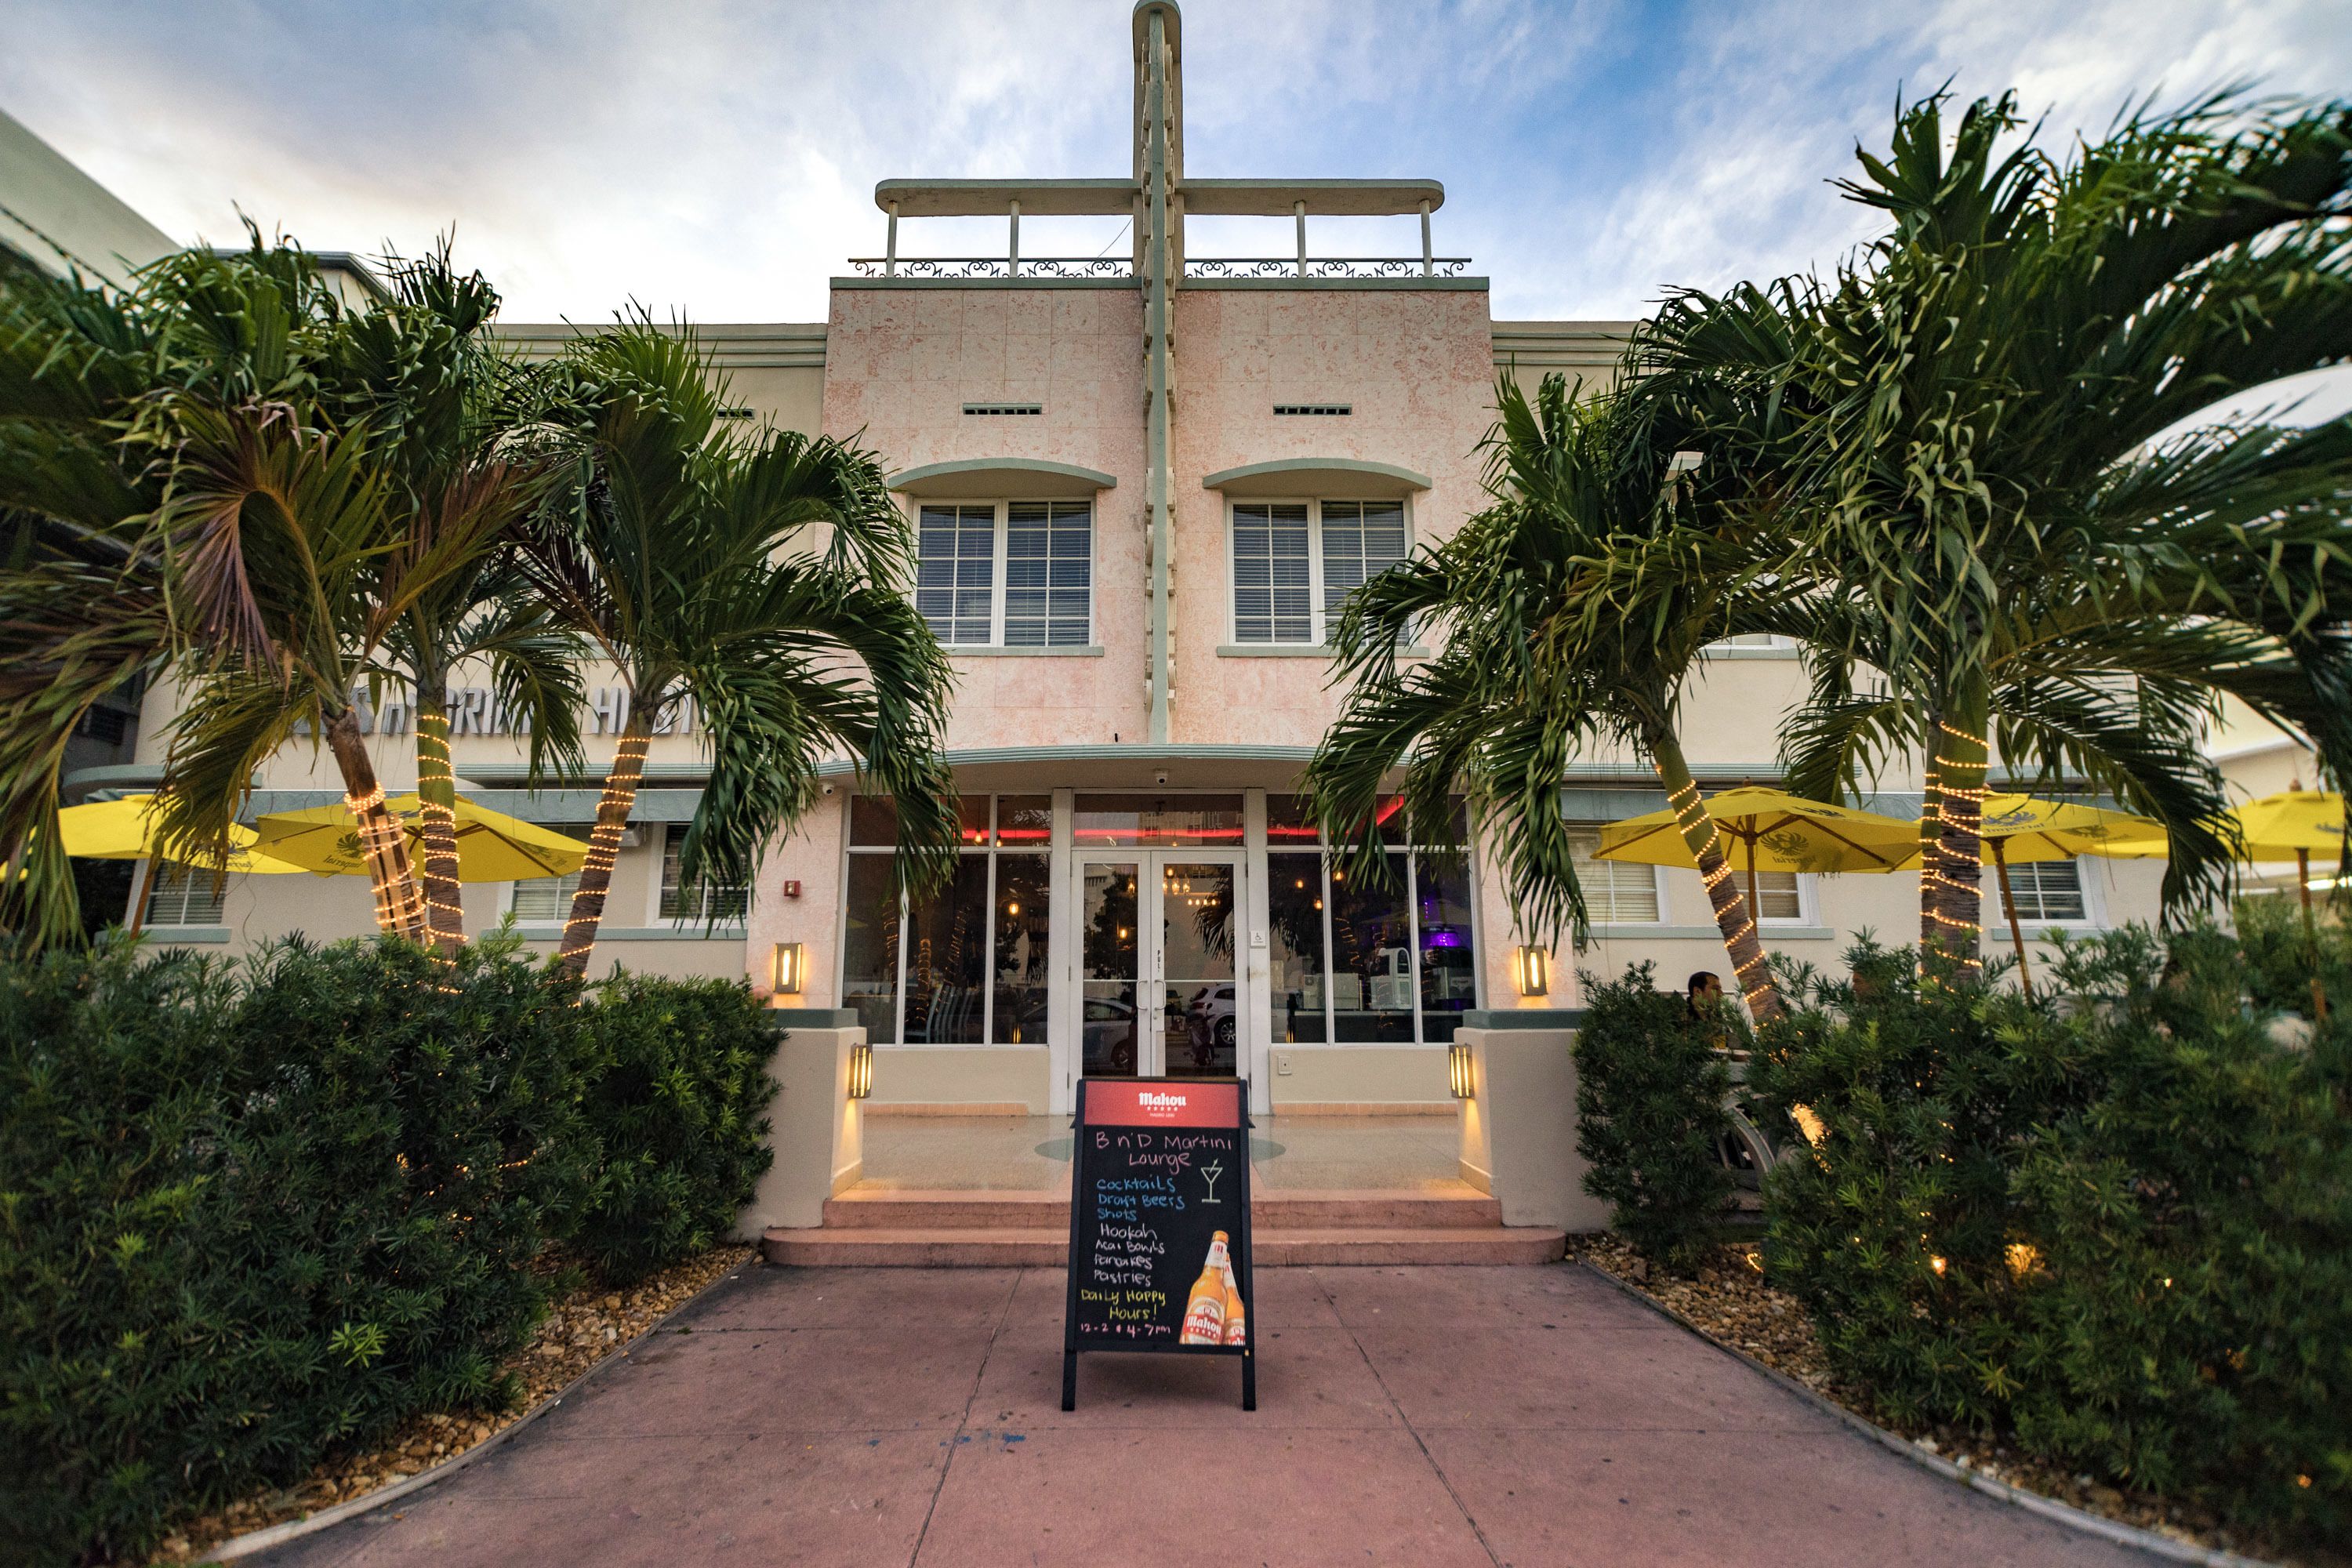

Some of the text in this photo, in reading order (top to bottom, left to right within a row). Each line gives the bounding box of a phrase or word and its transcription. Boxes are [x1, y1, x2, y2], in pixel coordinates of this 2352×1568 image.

[1985, 823, 2045, 833] Imperial
[1138, 1092, 1186, 1106] Mahou
[1096, 1131, 1110, 1149] B
[1164, 1134, 1232, 1150] Martini
[1129, 1152, 1192, 1174] Lounge
[1098, 1193, 1185, 1210] Draft Beers
[1097, 1207, 1138, 1221] Shots
[1100, 1222, 1157, 1240] Hookah
[1094, 1253, 1153, 1270] Pancakes
[1094, 1269, 1152, 1287] Pastries
[1126, 1289, 1166, 1307] Happy
[1109, 1304, 1157, 1321] Hours!
